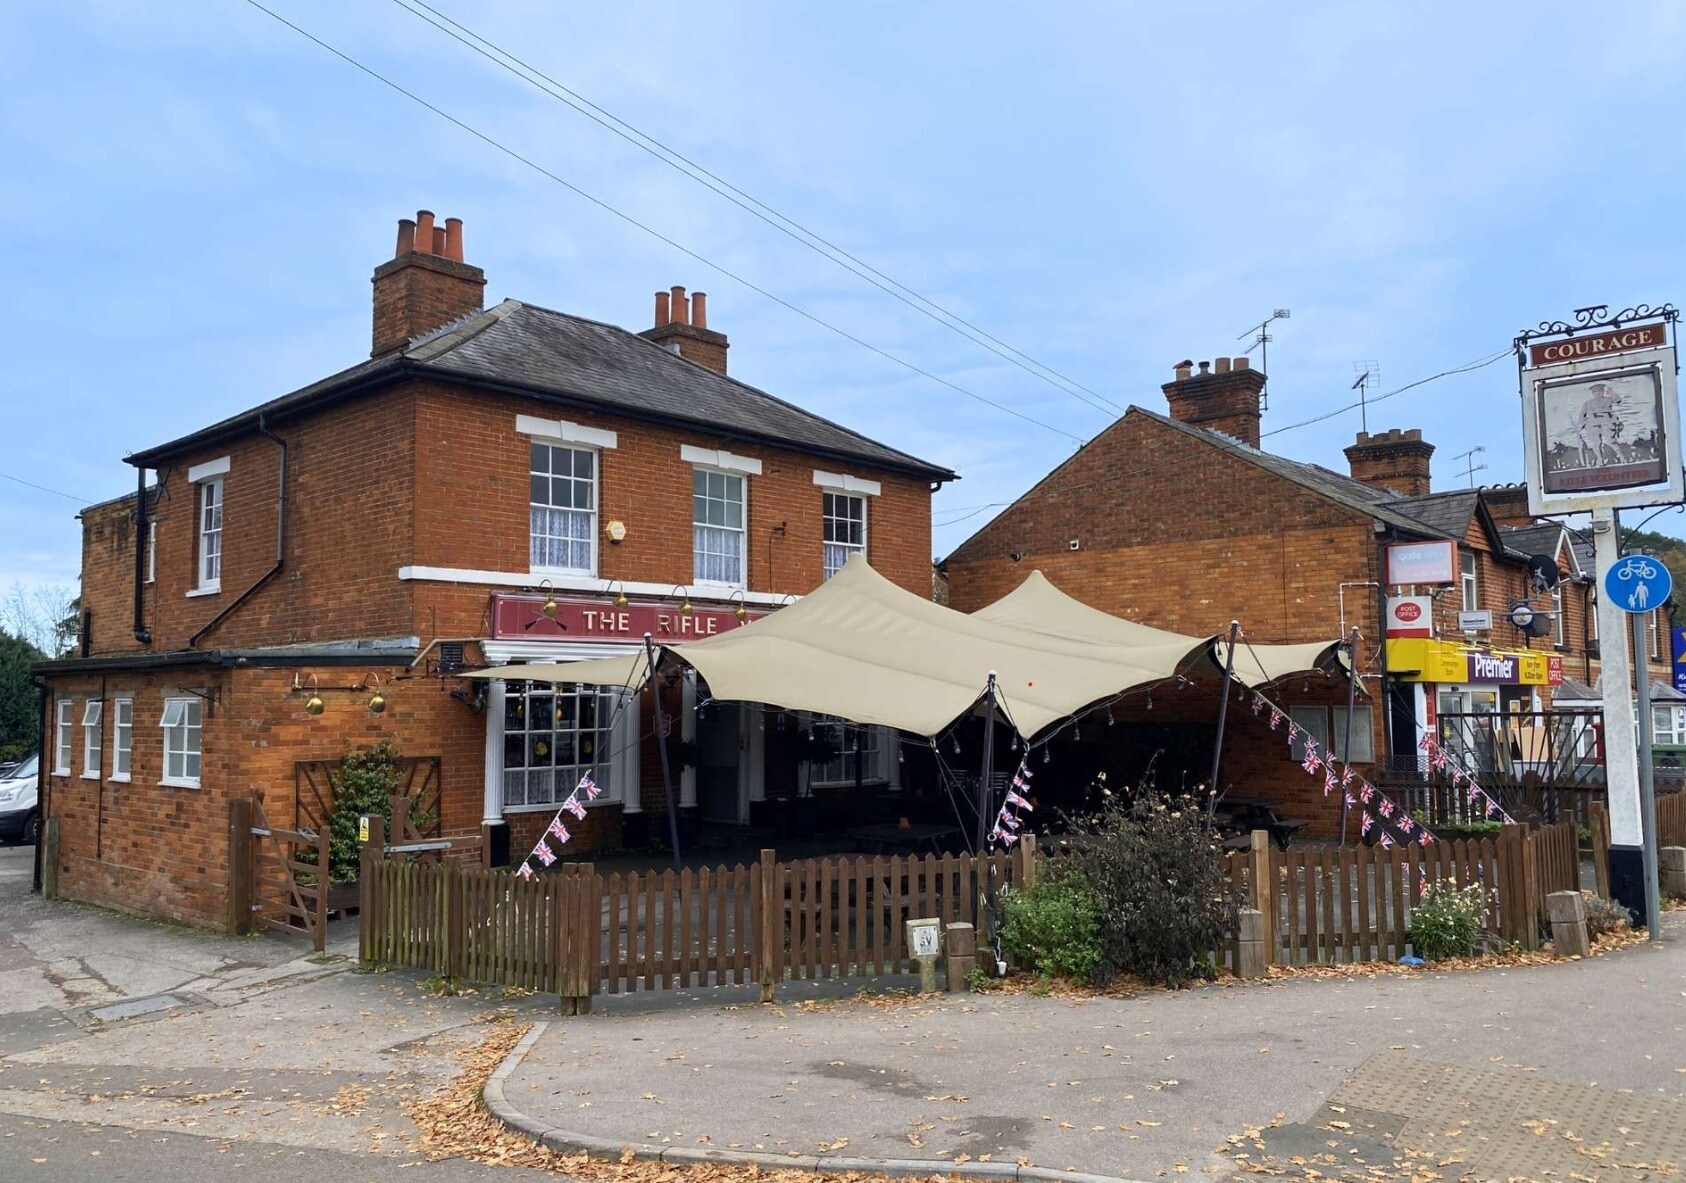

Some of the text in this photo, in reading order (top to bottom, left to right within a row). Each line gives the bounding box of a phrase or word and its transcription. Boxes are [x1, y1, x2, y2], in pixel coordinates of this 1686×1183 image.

[1543, 329, 1653, 360] COURAGE
[583, 610, 717, 635] THE RIFLE
[1475, 652, 1514, 679] Premier
[1548, 670, 1562, 681] OFFICE
[1550, 657, 1560, 669] POST
